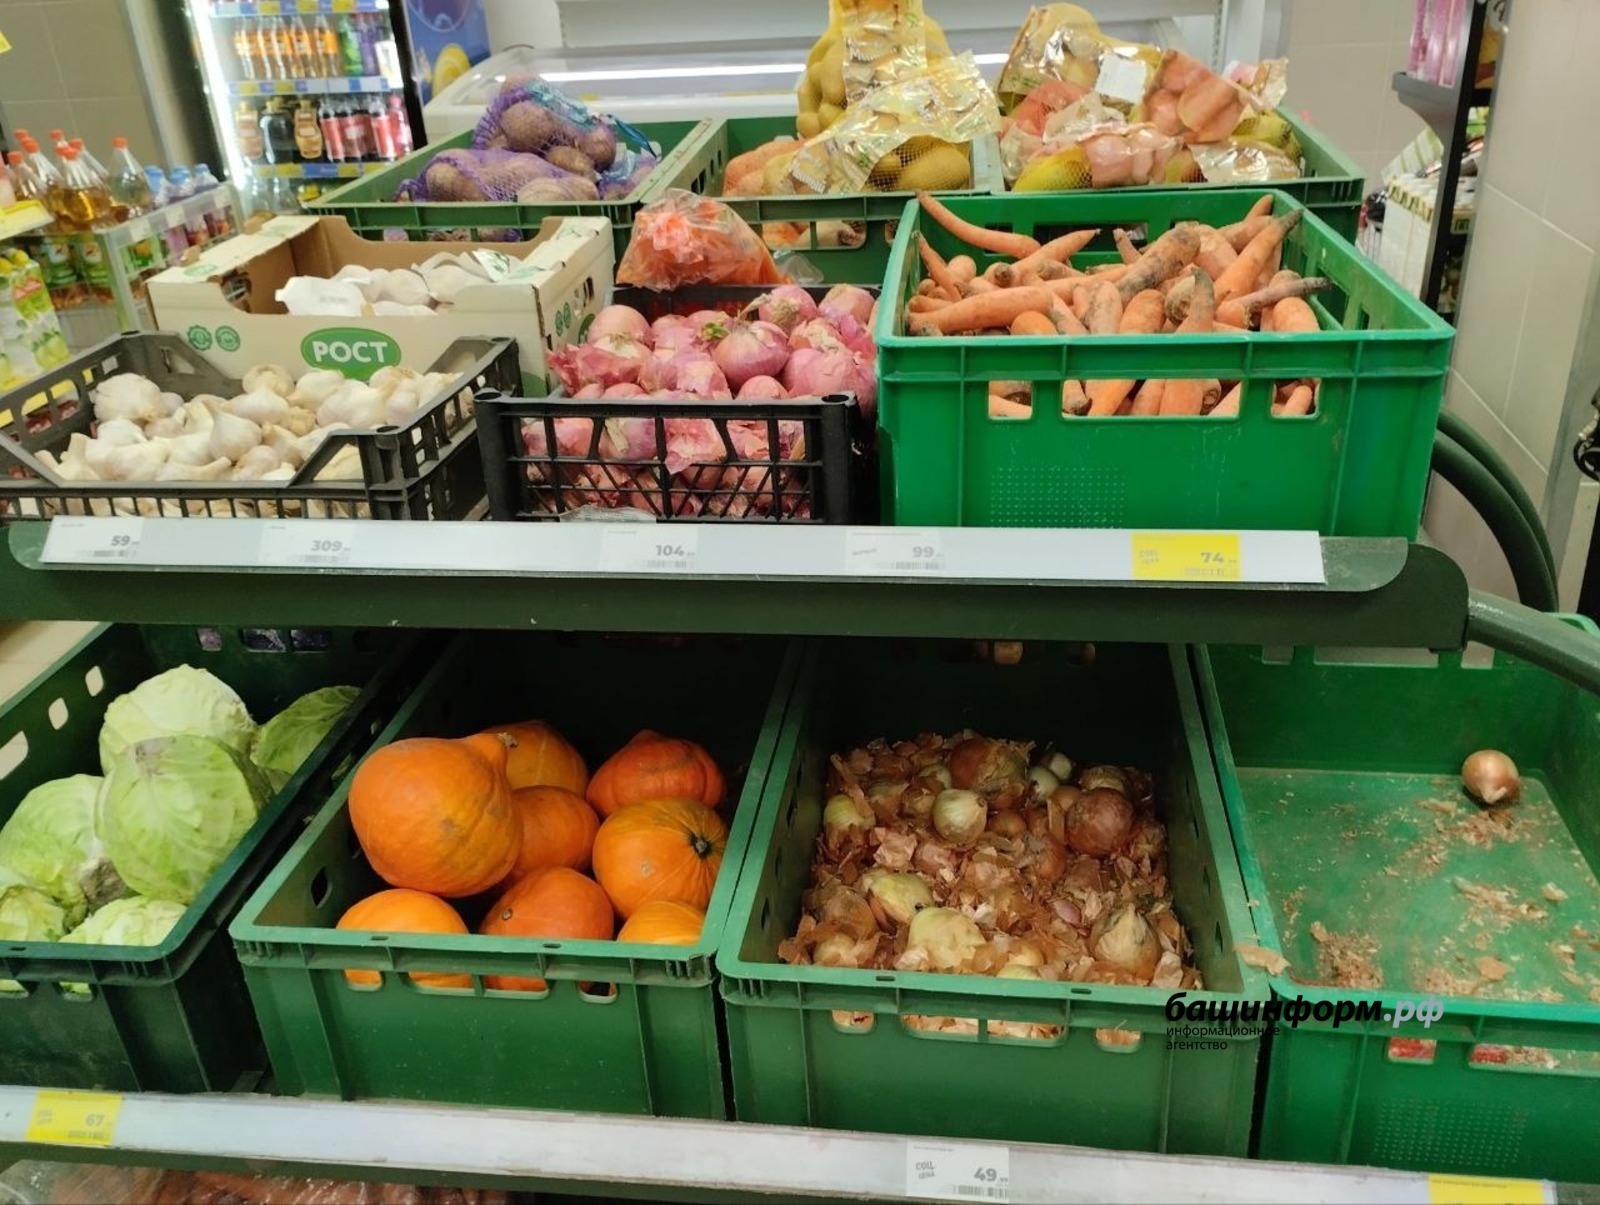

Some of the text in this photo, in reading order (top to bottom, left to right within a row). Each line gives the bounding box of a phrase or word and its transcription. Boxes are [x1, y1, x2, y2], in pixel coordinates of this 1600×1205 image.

[312, 340, 388, 363] РОСТ
[111, 535, 131, 547] 59
[311, 540, 343, 552] 309
[655, 544, 685, 557] 104
[912, 546, 935, 558] 99
[1200, 551, 1225, 564] 74
[974, 1168, 998, 1182] 49
